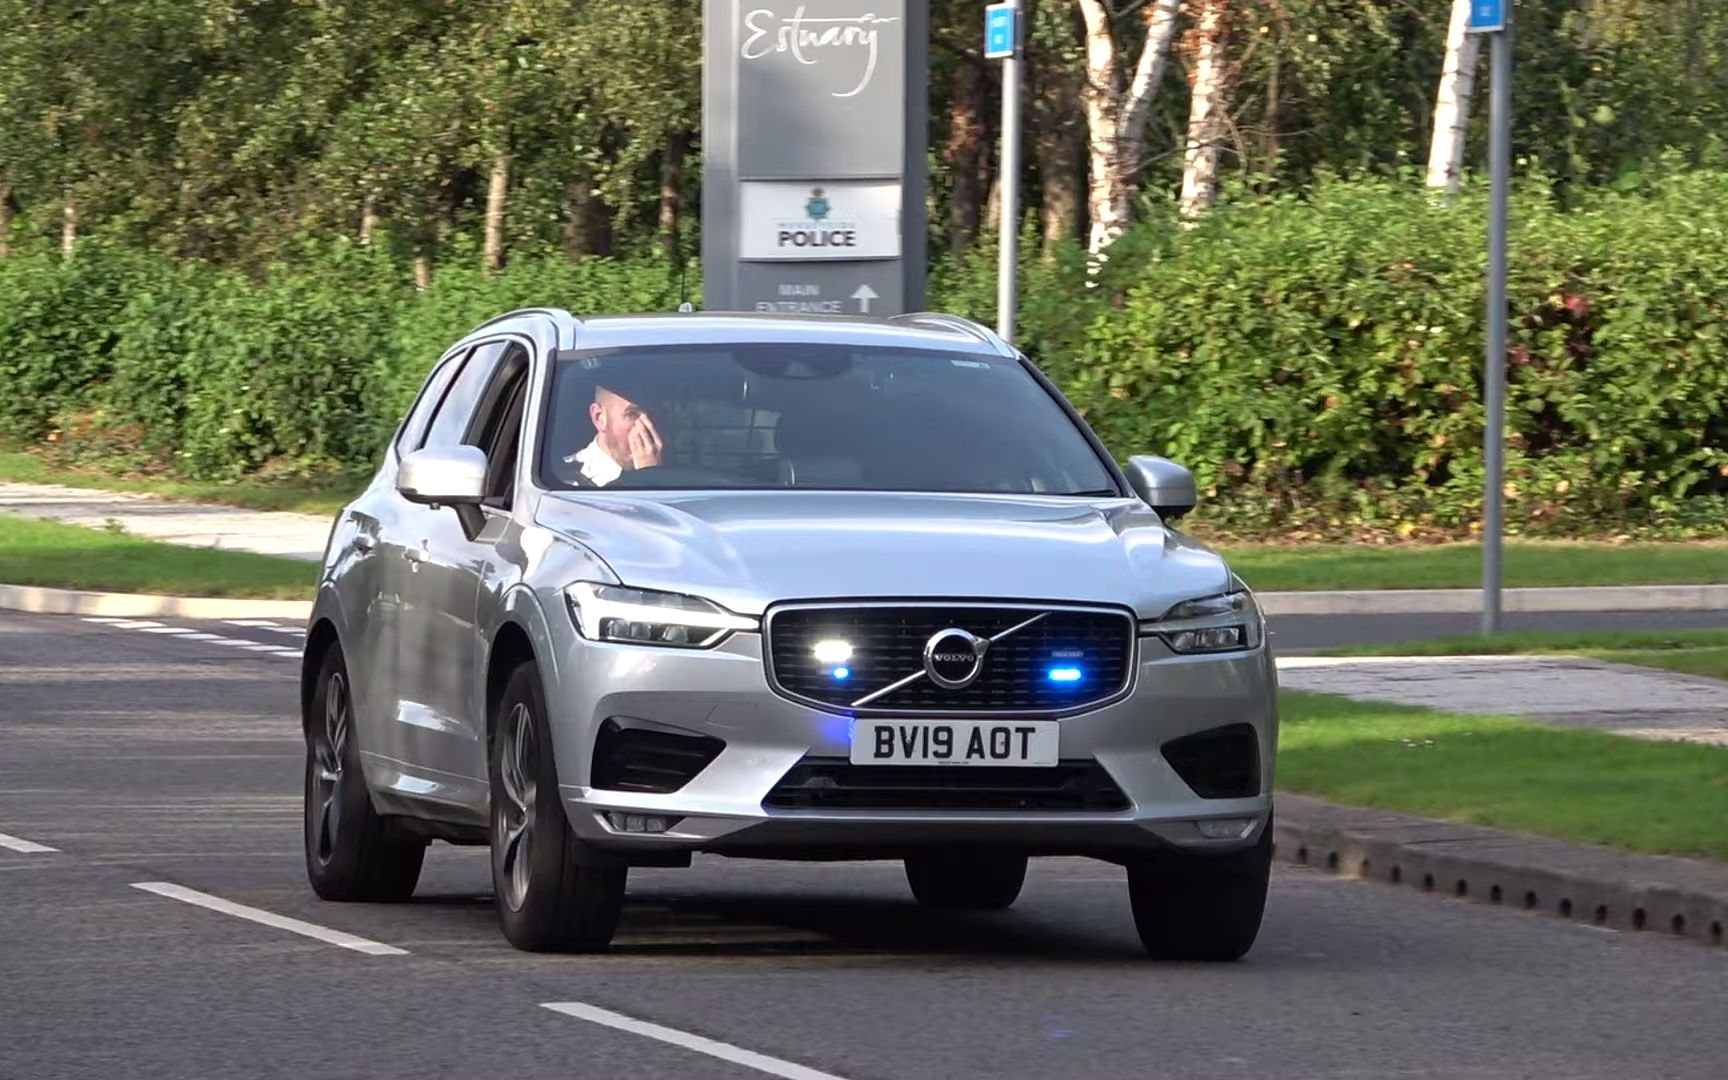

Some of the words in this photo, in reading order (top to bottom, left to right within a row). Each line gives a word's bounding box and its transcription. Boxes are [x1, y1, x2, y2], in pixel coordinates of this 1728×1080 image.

[741, 6, 902, 97] Estuary
[778, 231, 856, 247] POLICE
[756, 301, 842, 313] ENTRANCE
[934, 654, 974, 662] VOLVO
[873, 725, 954, 759] BV19
[965, 726, 1036, 760] AOT
